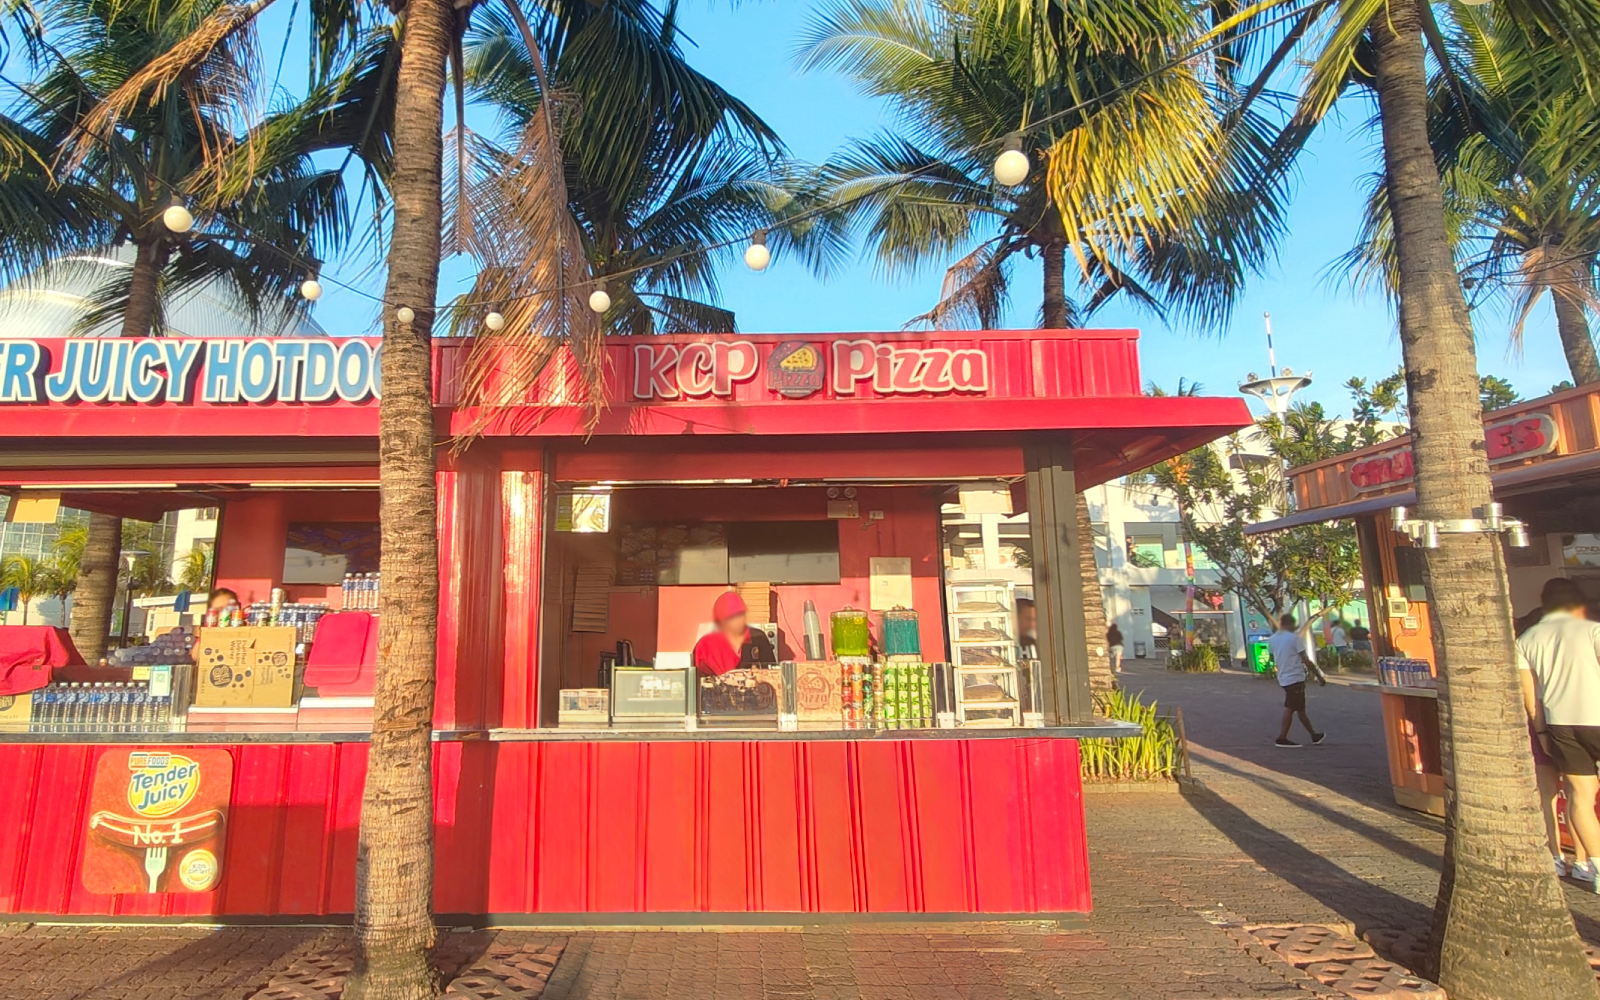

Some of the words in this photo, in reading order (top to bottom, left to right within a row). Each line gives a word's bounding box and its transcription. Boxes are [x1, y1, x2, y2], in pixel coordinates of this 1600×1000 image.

[0, 339, 40, 402] R
[45, 339, 202, 402] JUICY
[634, 340, 759, 398] KCP
[832, 339, 988, 393] Pizza
[767, 368, 822, 388] Pizza
[132, 764, 197, 793] Tender
[137, 782, 188, 810] Juicy
[133, 823, 166, 846] No.
[170, 821, 184, 845] 1
